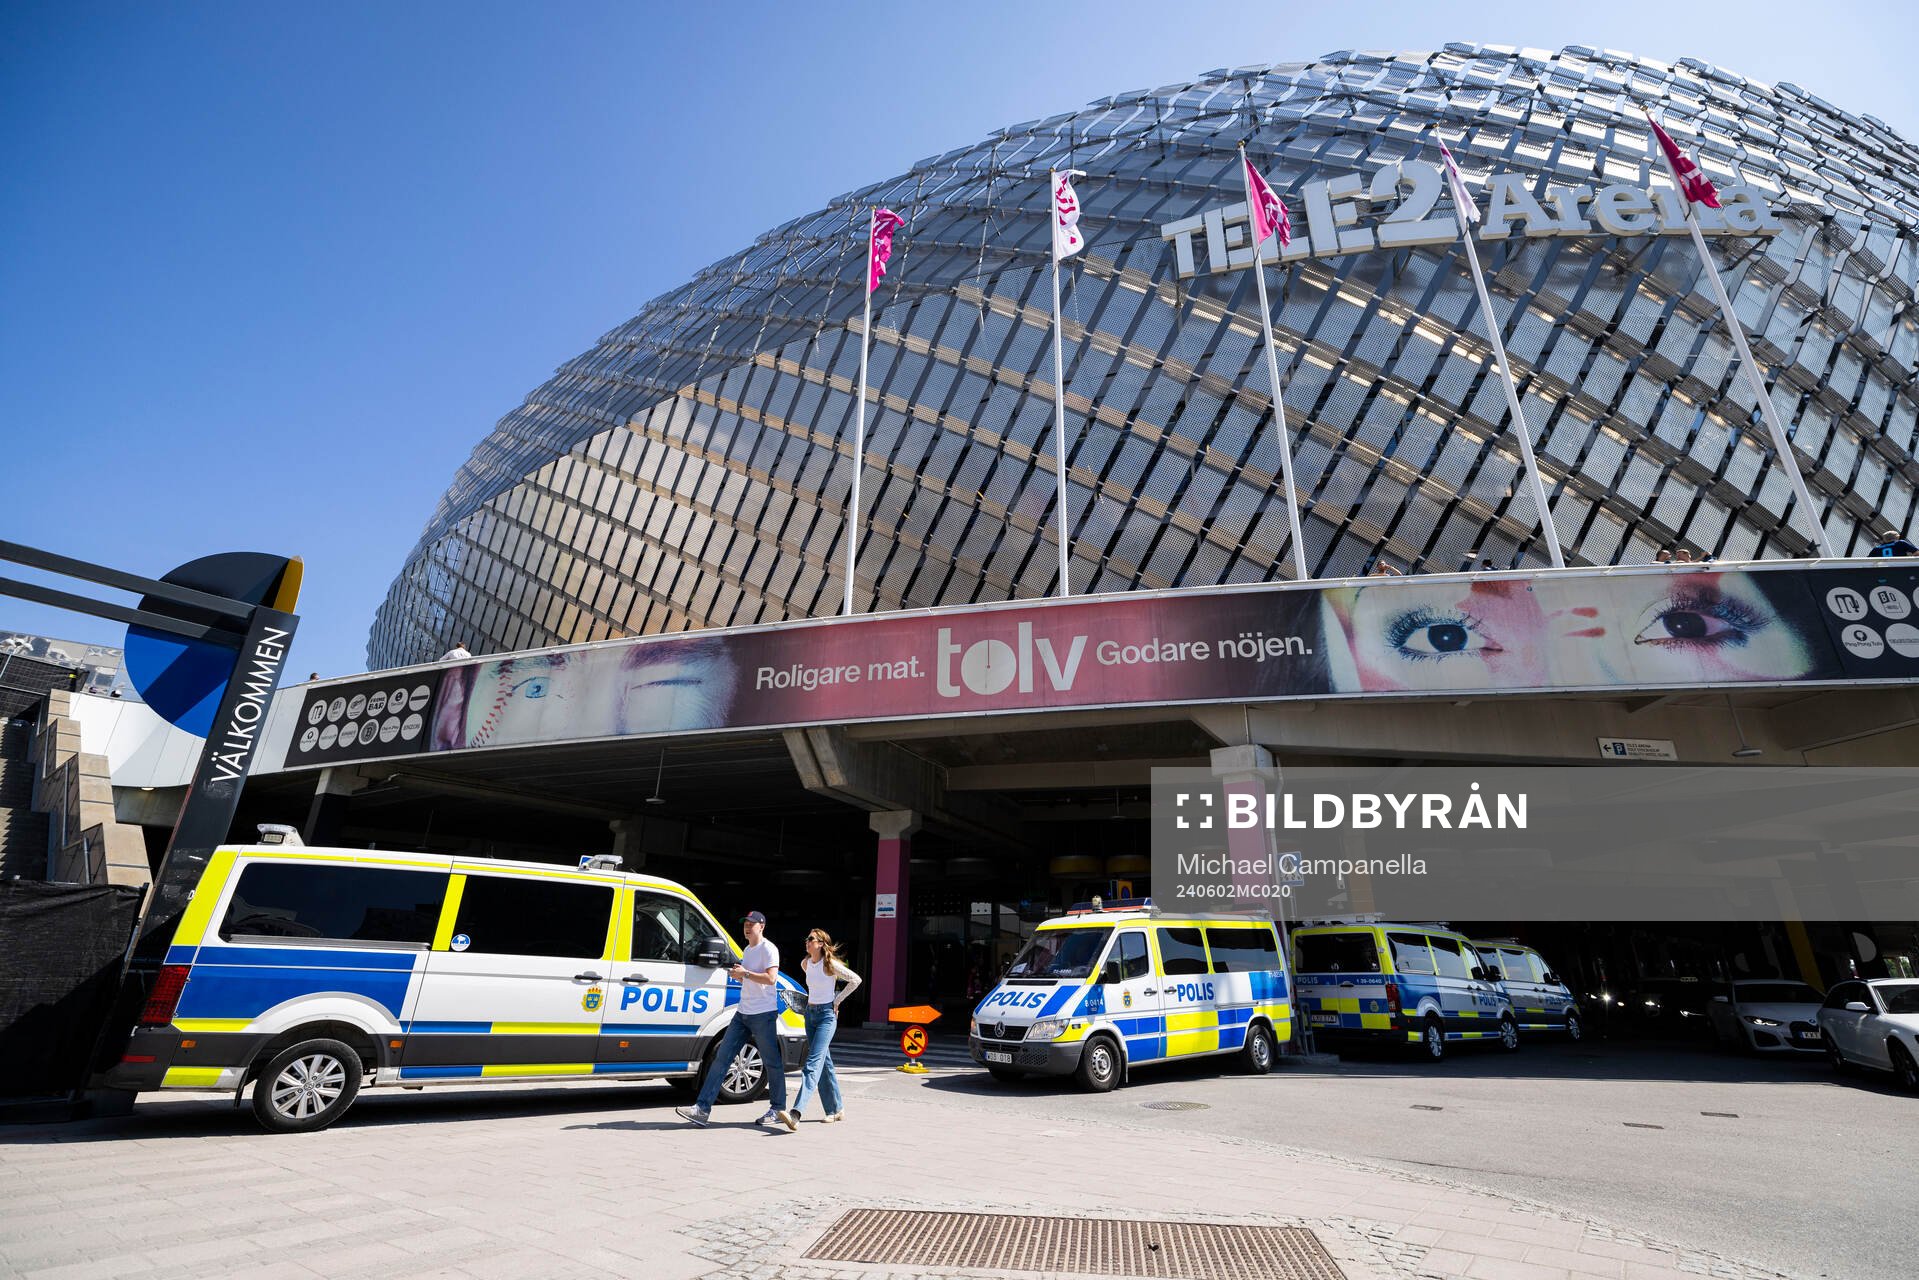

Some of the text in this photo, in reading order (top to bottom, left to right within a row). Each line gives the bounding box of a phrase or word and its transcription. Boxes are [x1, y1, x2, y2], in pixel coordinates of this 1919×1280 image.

[1161, 160, 1784, 278] TELE2 Arena
[937, 622, 1088, 697] tolv
[1097, 632, 1313, 665] Godare nöjen.
[756, 656, 925, 691] Roligare mat.
[211, 627, 289, 781] VÄLKOMMEN
[1177, 982, 1214, 1002] POLIS
[1297, 976, 1318, 984] POLIS
[620, 986, 708, 1014] POLIS
[986, 991, 1047, 1009] POLIS
